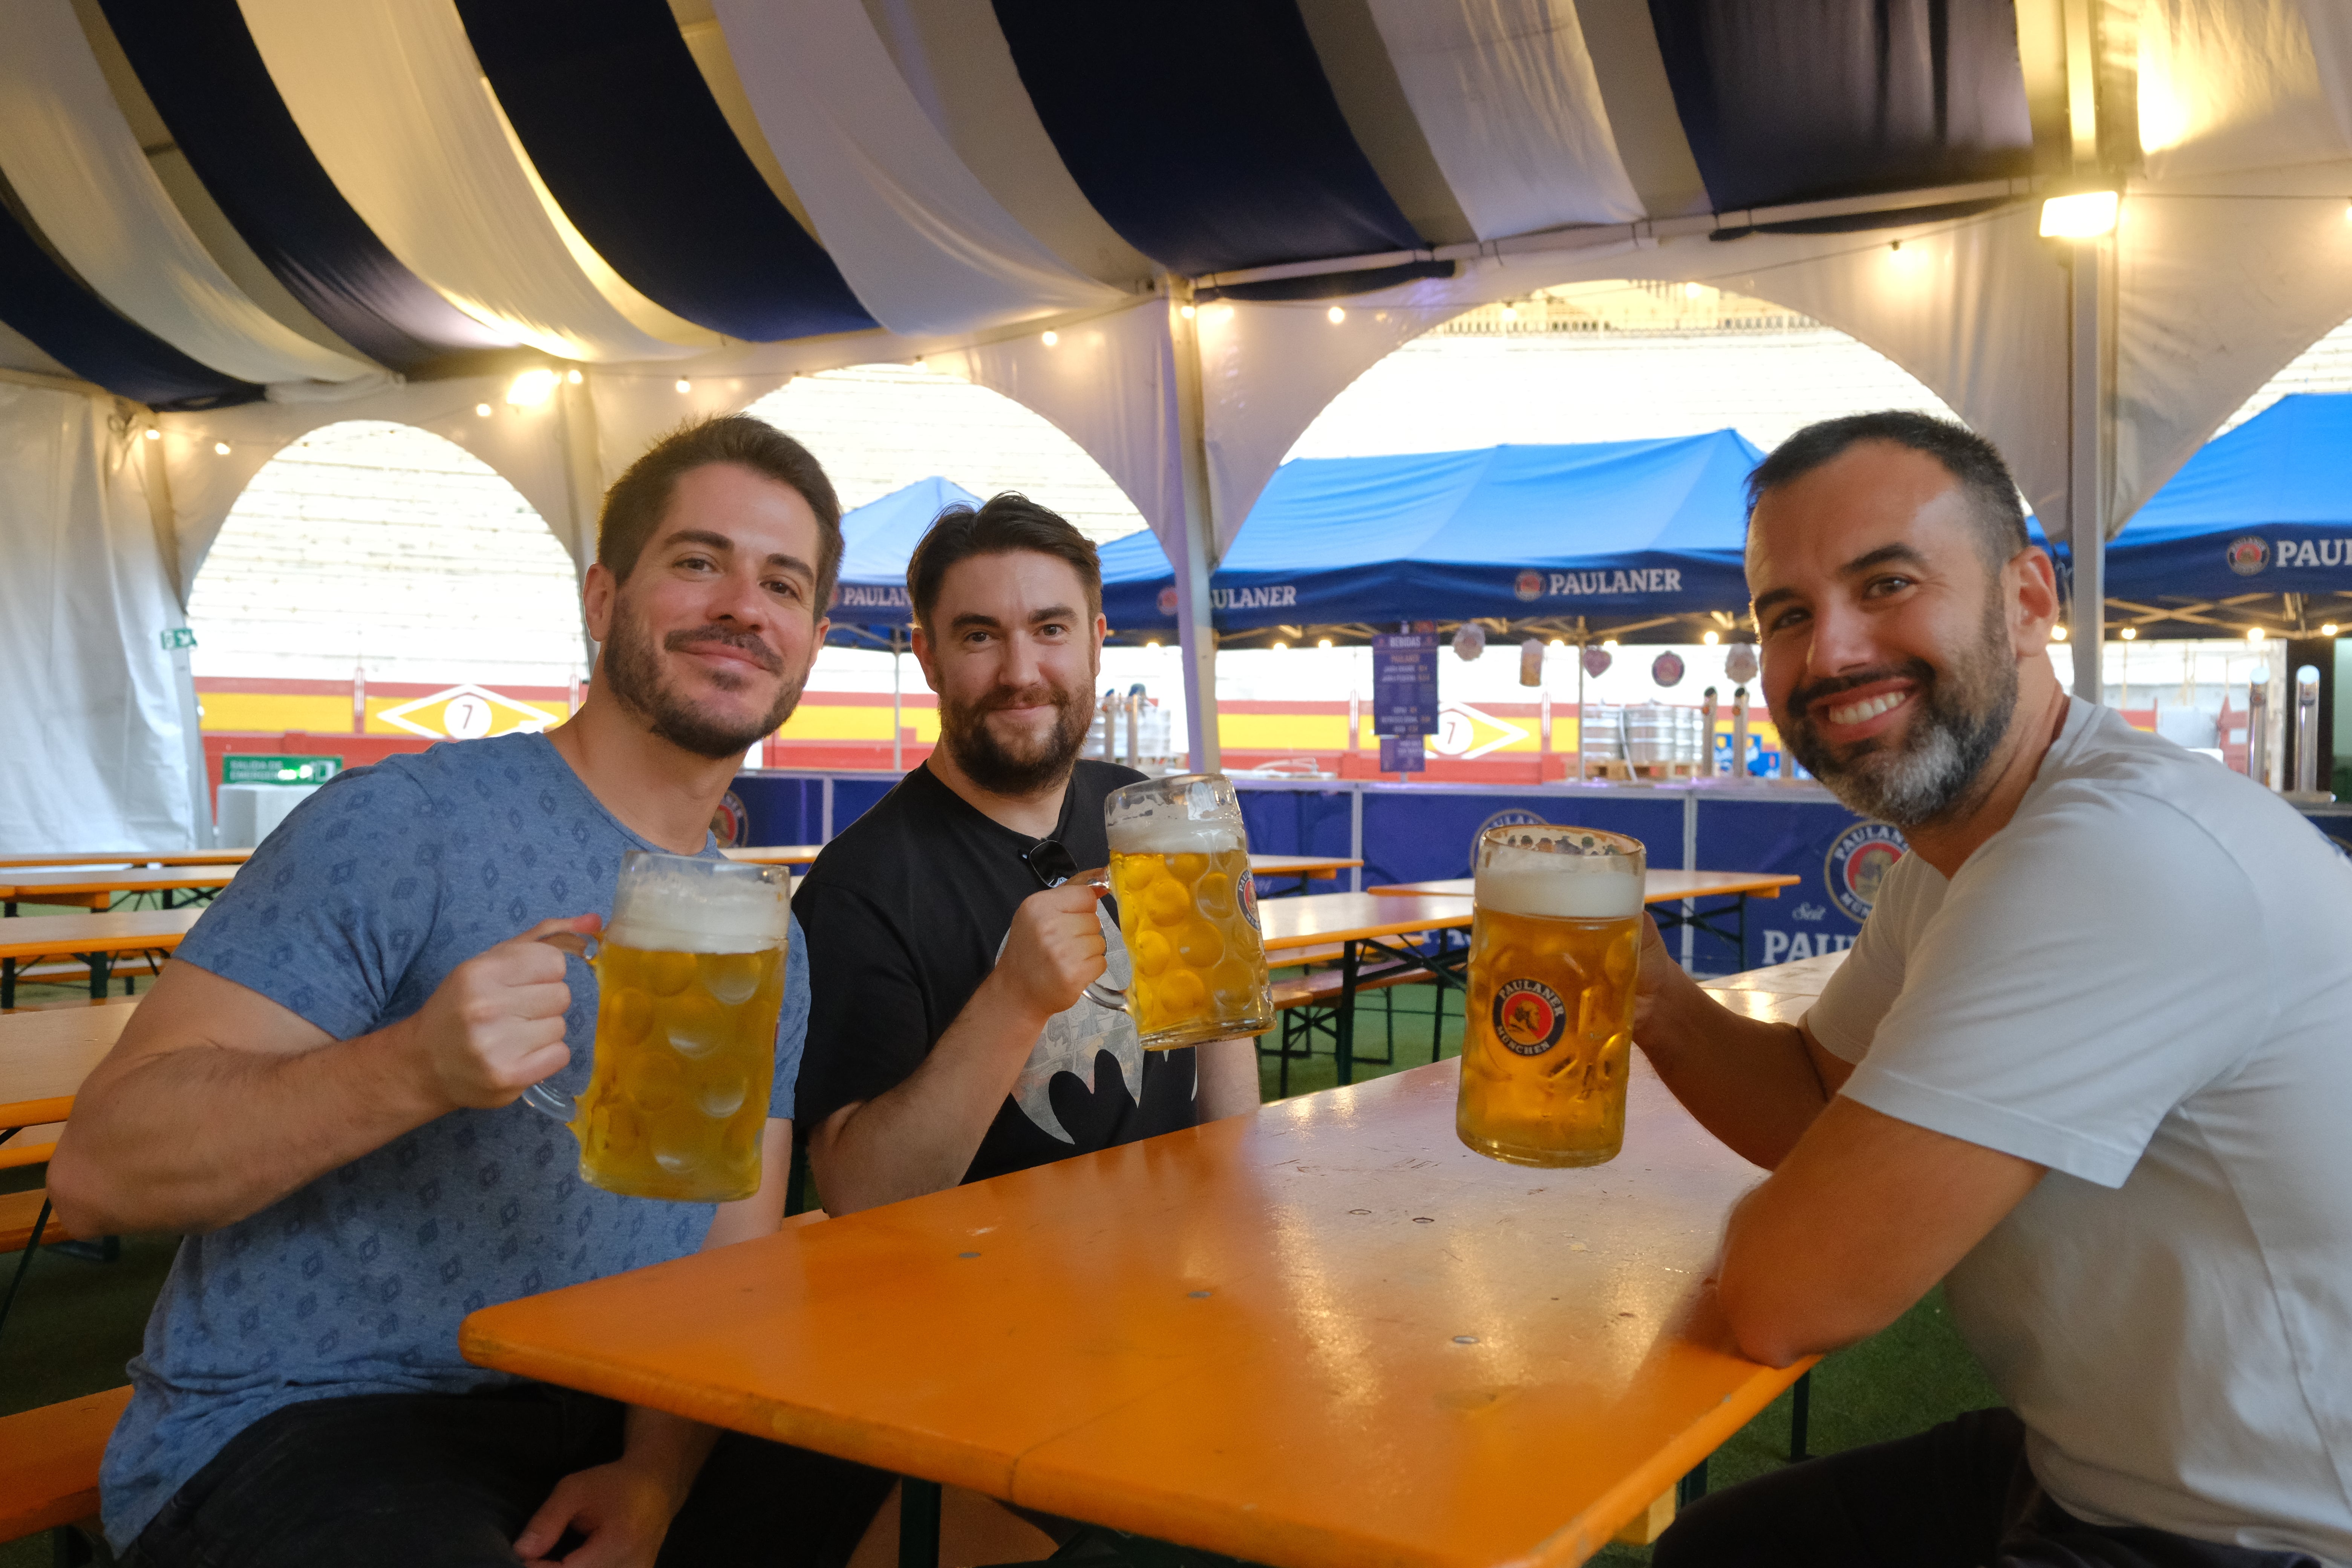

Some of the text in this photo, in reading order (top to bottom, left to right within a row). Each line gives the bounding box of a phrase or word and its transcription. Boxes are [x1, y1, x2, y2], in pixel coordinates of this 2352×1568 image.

[1550, 568, 1682, 595] PAULANER
[844, 587, 912, 606] PAULAN
[1210, 585, 1297, 609] ULANER
[462, 704, 473, 730] 7
[1447, 721, 1456, 744] 7
[1834, 826, 1909, 861] PAULAN
[1499, 980, 1564, 1017] PAULANER
[1497, 1025, 1550, 1055] MÜNCHEN
